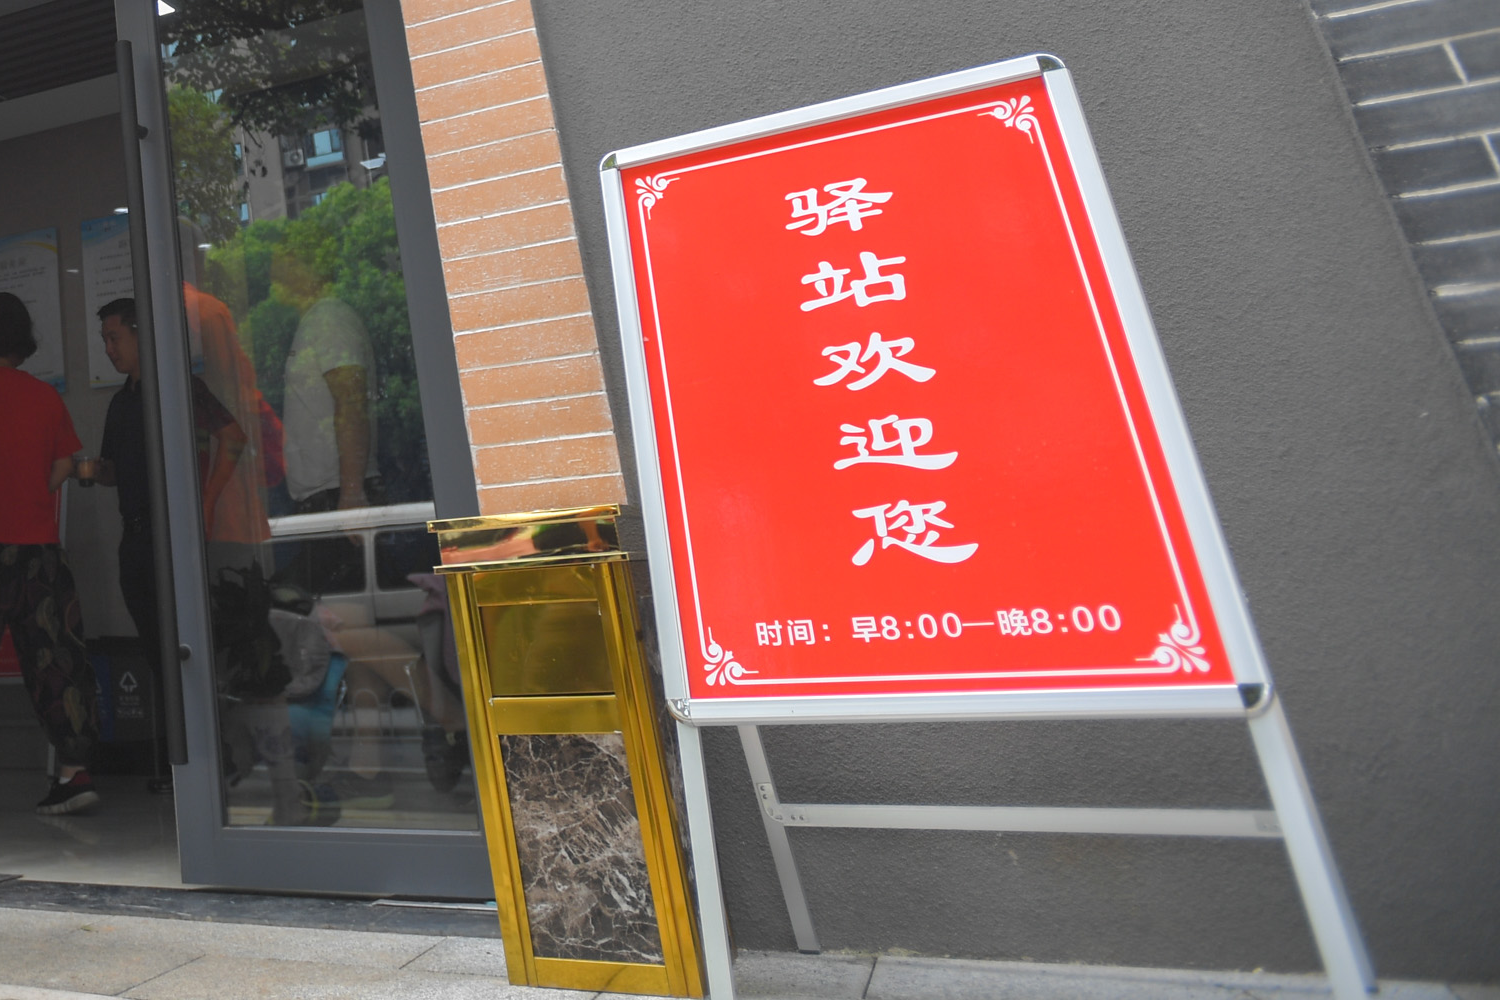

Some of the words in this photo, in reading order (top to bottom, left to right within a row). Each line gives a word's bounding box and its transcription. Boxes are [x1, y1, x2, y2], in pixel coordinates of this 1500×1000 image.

[784, 177, 979, 566] 驿站欢迎您
